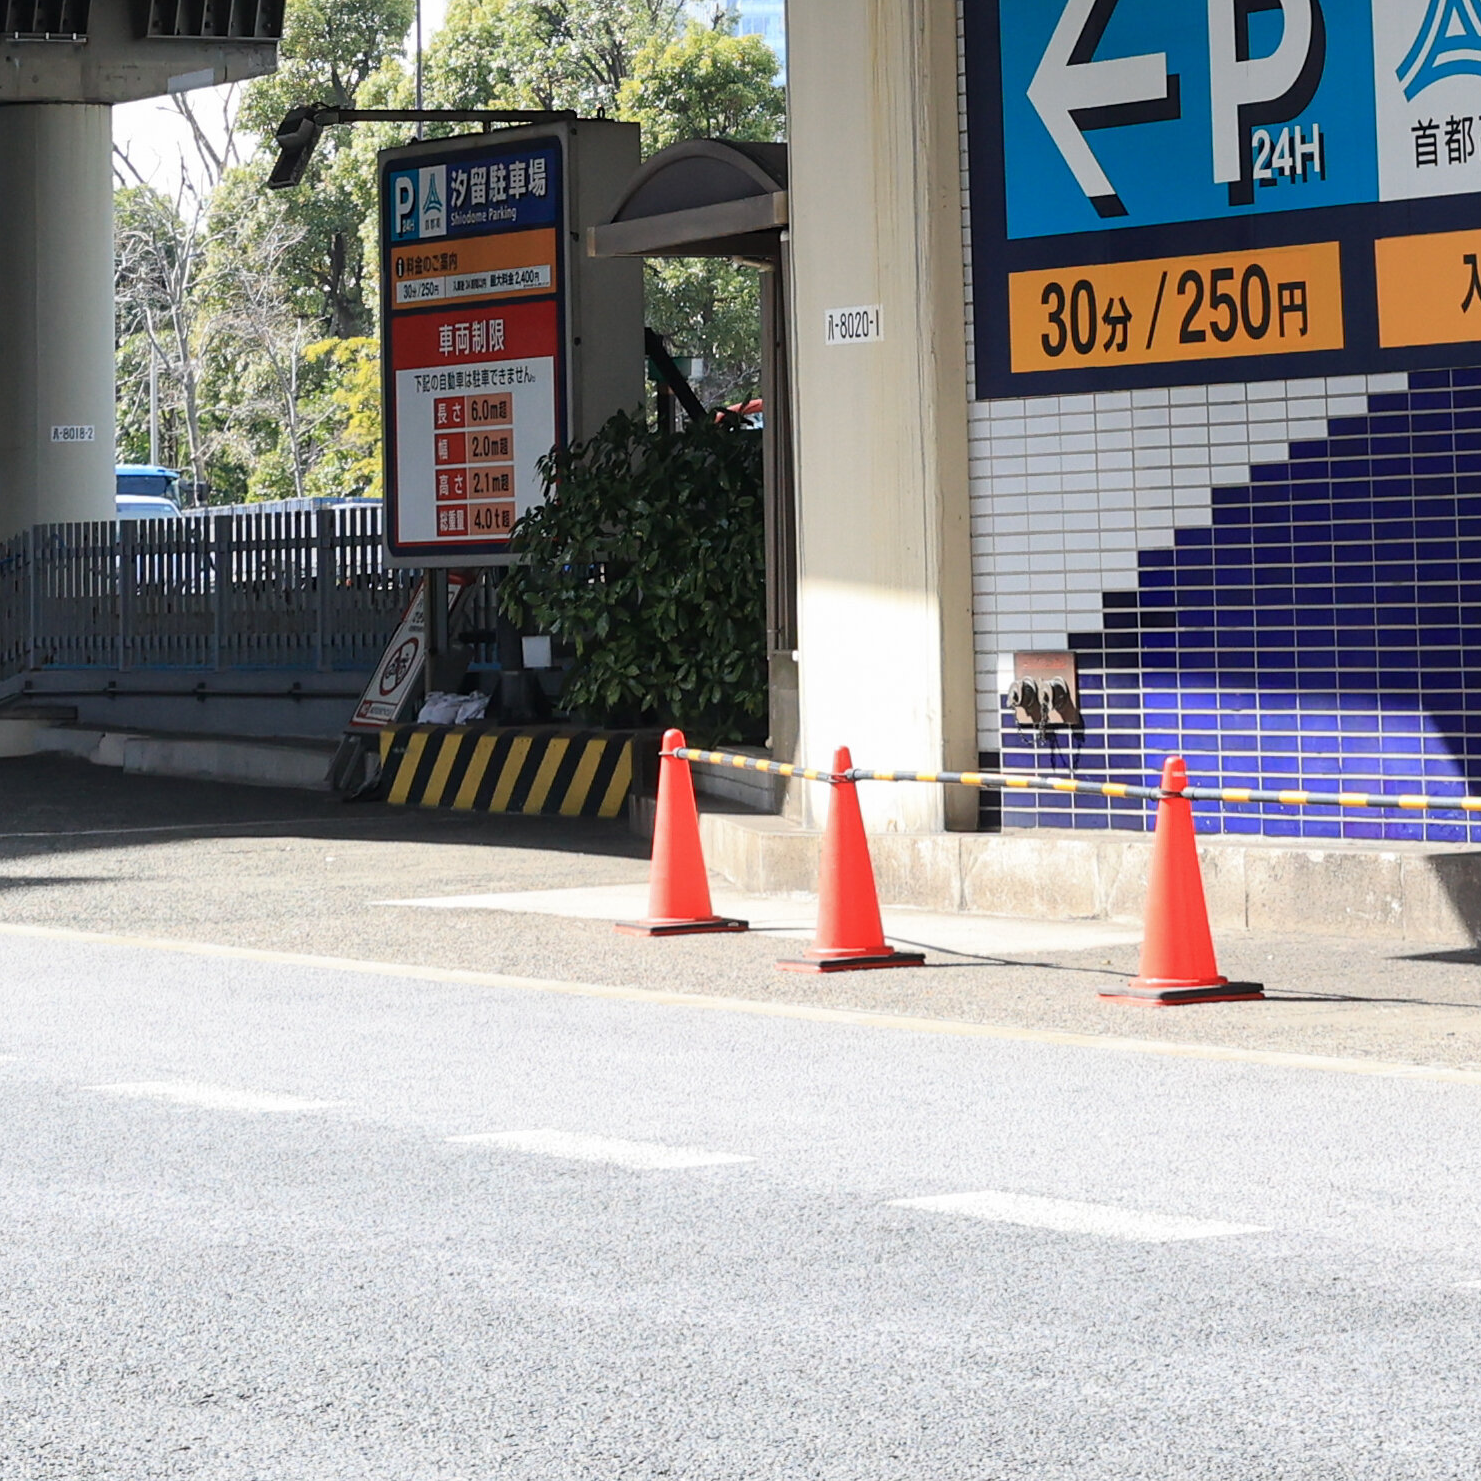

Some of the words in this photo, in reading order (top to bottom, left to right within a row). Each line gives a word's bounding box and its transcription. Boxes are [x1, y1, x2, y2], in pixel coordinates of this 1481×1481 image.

[1251, 122, 1321, 180] 24H
[450, 158, 546, 209] 汐留駐車場
[395, 176, 415, 234] P
[450, 210, 487, 227] Shiodome
[488, 206, 517, 222] Parking
[406, 252, 458, 276] 料金のご案内
[438, 319, 505, 357] 車両制限
[437, 402, 461, 424] 長さ
[471, 399, 507, 421] 6.0m超
[472, 435, 508, 457] 2.0m超
[439, 474, 463, 496] 高さ
[473, 472, 509, 493] 2.1m超
